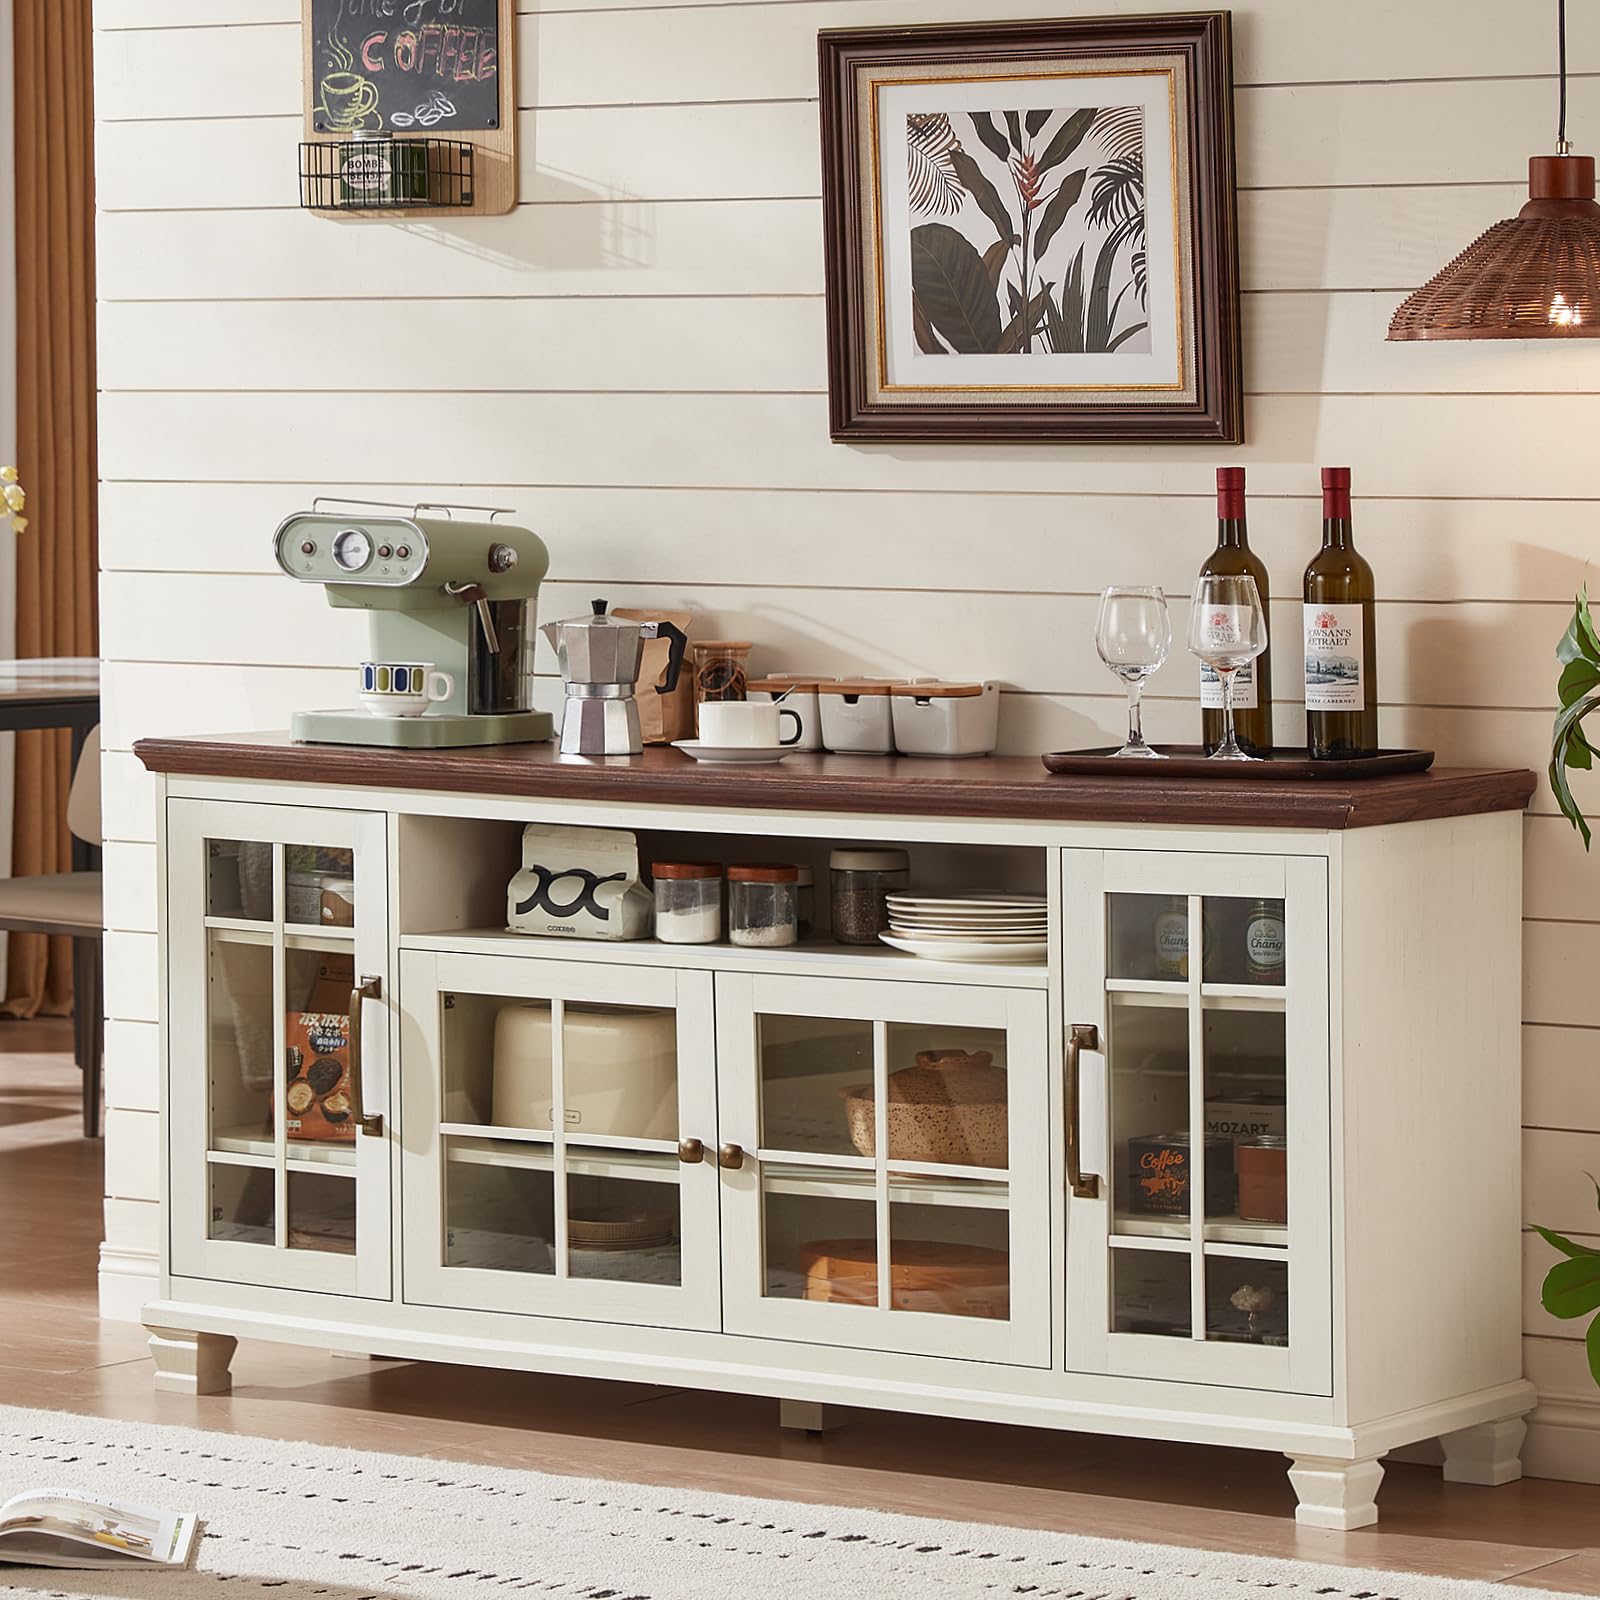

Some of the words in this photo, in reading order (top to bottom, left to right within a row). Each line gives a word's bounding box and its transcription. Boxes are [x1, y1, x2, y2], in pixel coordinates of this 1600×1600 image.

[361, 24, 496, 81] COFFEE
[1250, 937, 1282, 951] Chang
[1207, 1121, 1270, 1136] MOZART
[1140, 1149, 1185, 1170] Coffee
